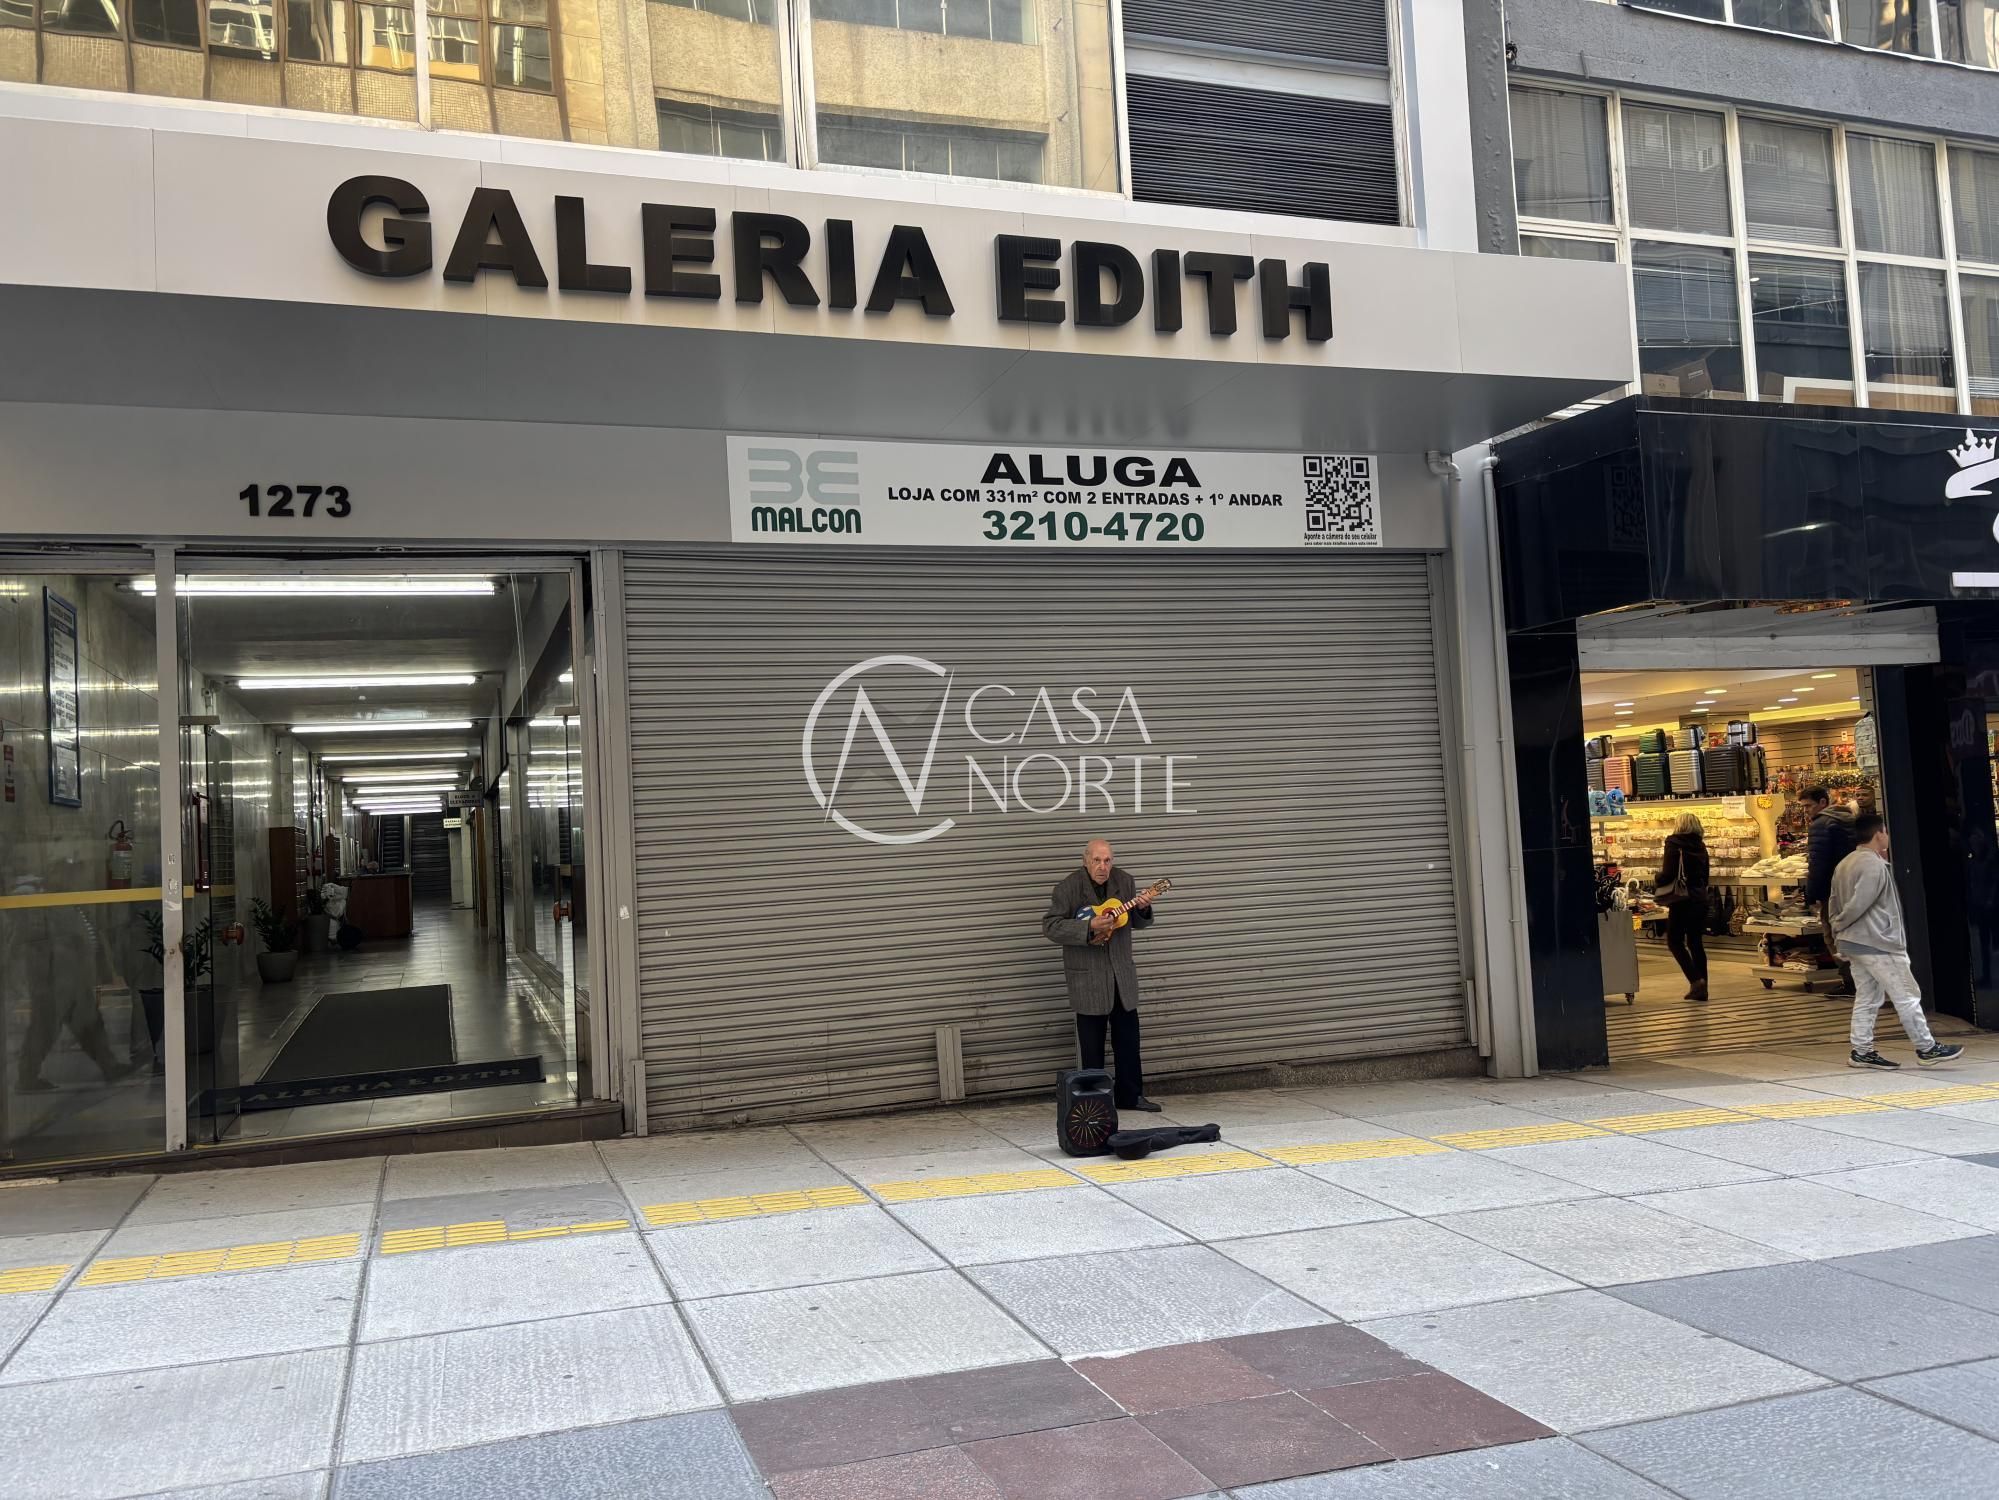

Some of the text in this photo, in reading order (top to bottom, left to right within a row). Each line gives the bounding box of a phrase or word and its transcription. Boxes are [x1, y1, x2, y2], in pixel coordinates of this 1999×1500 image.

[326, 174, 1334, 345] GALERIA EDITH
[980, 453, 1202, 488] ALUGA
[239, 483, 352, 518] 1273
[888, 487, 935, 501] LOJA
[940, 489, 980, 502] COM
[1043, 491, 1082, 504] COM
[1086, 492, 1097, 504] 2
[1102, 492, 1190, 506] ENTRADAS
[1195, 495, 1204, 504] +
[1228, 494, 1283, 506] ANDAR
[751, 506, 862, 534] MALCON
[982, 510, 1205, 542] 3210-4720
